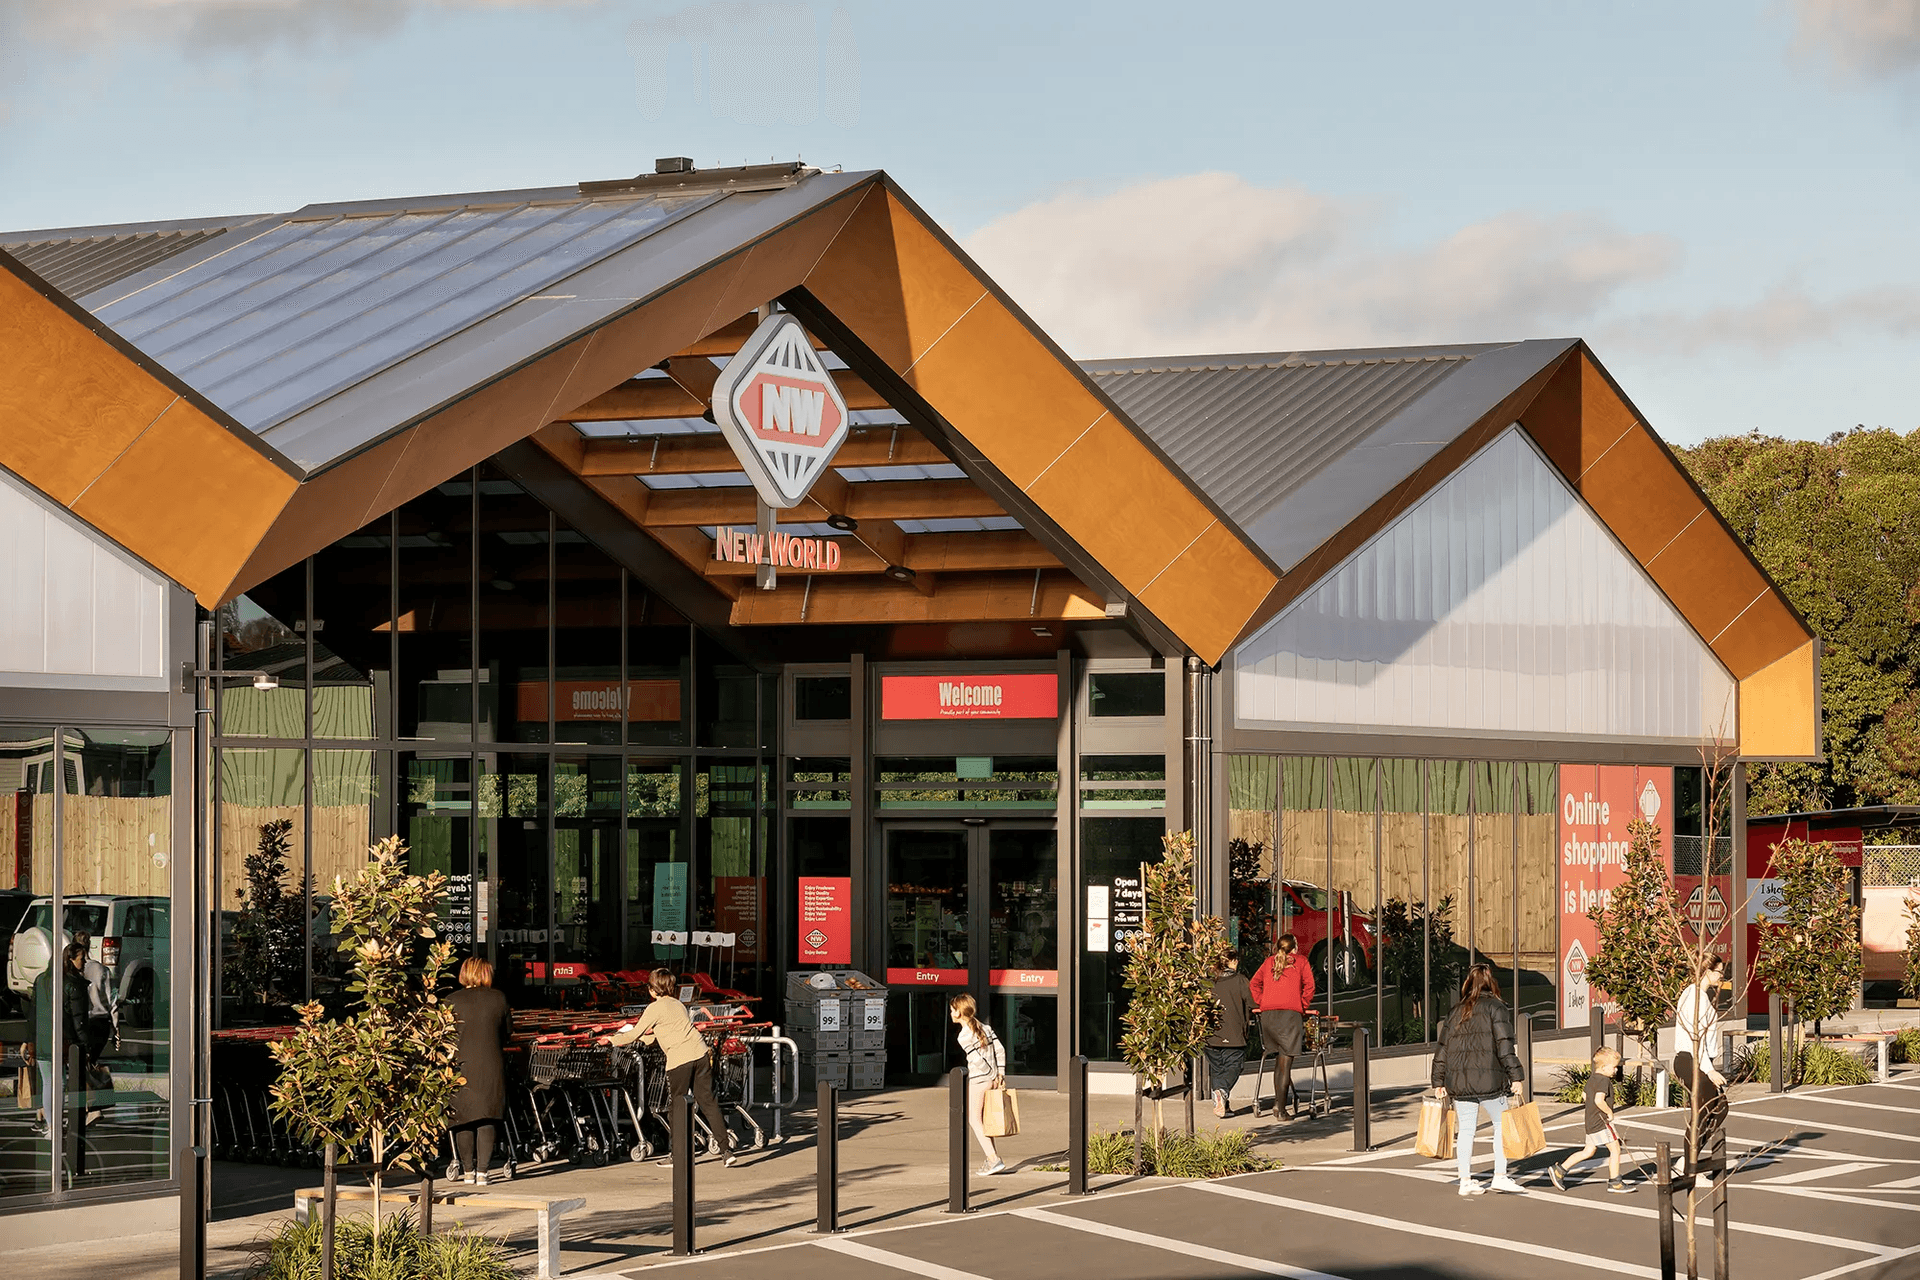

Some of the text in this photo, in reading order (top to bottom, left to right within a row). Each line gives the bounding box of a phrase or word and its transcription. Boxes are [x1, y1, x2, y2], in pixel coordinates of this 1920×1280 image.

[760, 382, 824, 436] NW
[716, 526, 841, 570] NEW WORLD
[939, 682, 1002, 707] Welcome
[1564, 792, 1610, 826] Online
[1564, 832, 1629, 873] shopping
[1114, 877, 1138, 888] Open
[1114, 888, 1143, 899] 7 days
[1564, 880, 1611, 914] is here
[916, 972, 939, 982] Entry
[1020, 973, 1044, 984] Entry
